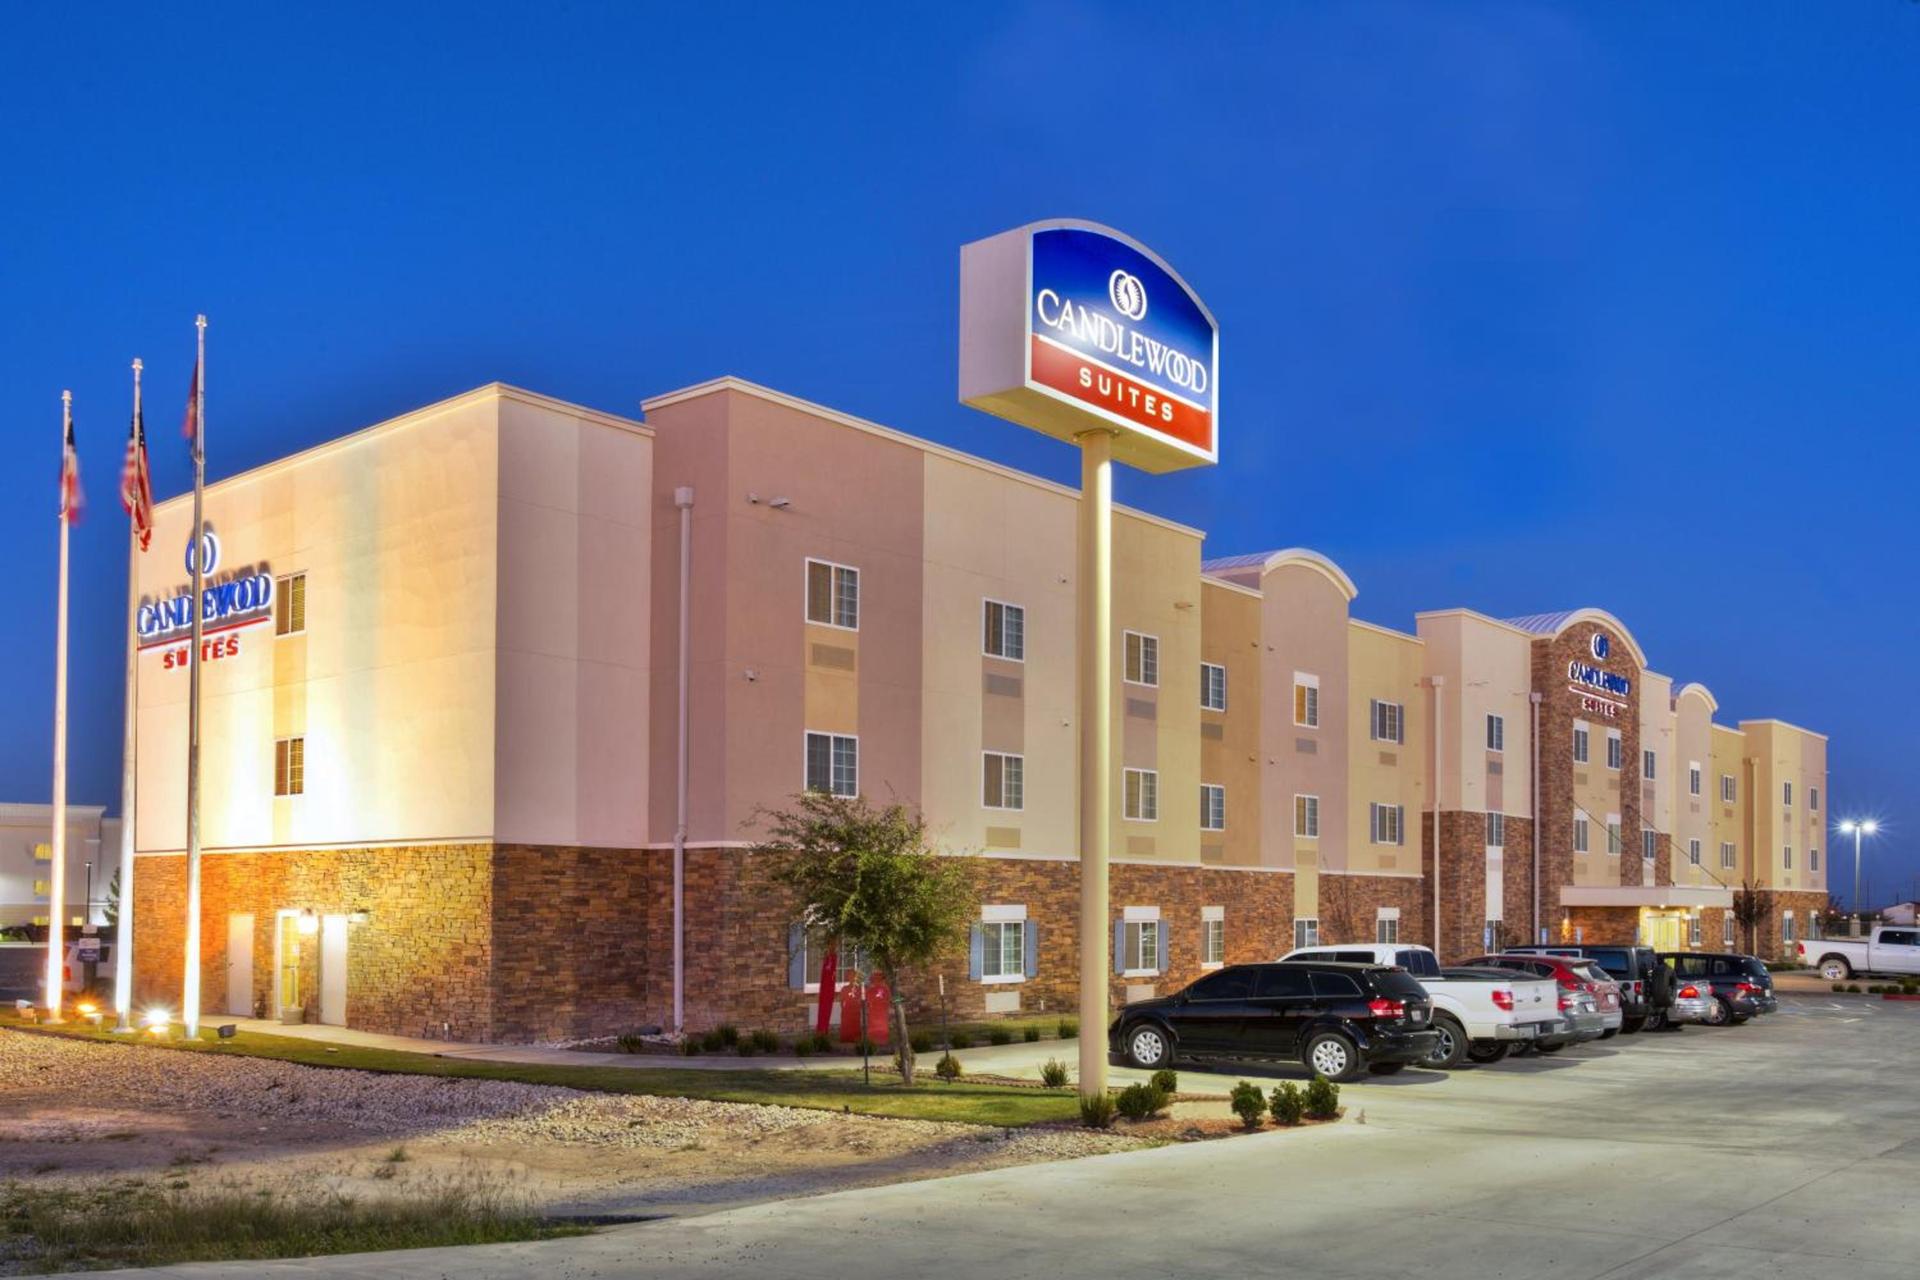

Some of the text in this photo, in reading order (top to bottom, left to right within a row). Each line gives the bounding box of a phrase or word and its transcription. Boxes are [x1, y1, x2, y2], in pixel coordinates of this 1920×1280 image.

[1037, 289, 1207, 393] CANDLEWOOD
[1079, 367, 1173, 422] SUITES
[137, 574, 271, 636] CANDEWOOD
[163, 638, 239, 669] SUTES
